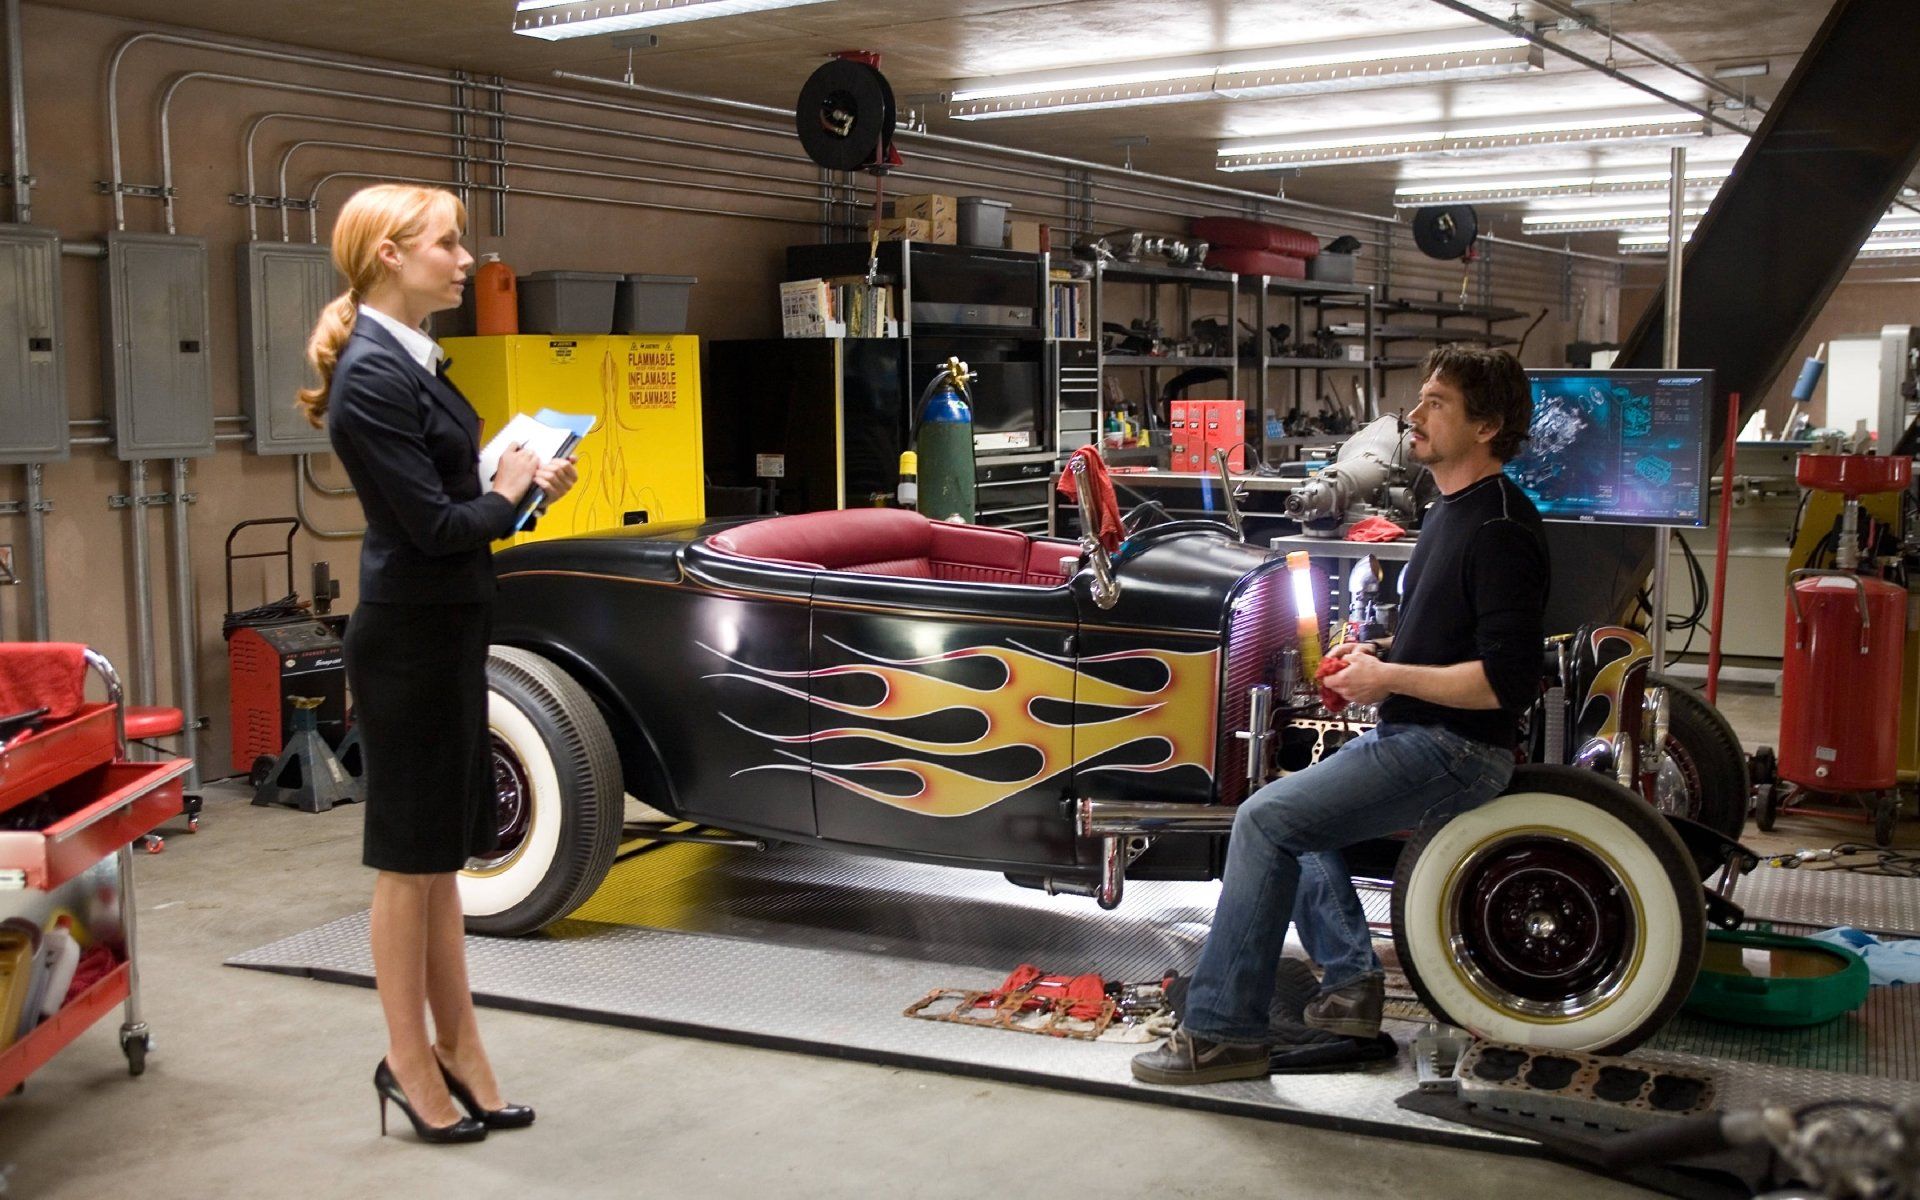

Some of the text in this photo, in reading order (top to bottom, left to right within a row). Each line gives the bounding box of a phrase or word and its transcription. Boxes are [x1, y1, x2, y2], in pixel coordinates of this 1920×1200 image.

[628, 353, 675, 366] FLAMMABLE
[628, 372, 676, 386] INFLAMABLE
[629, 391, 676, 405] INFLAMMABLE
